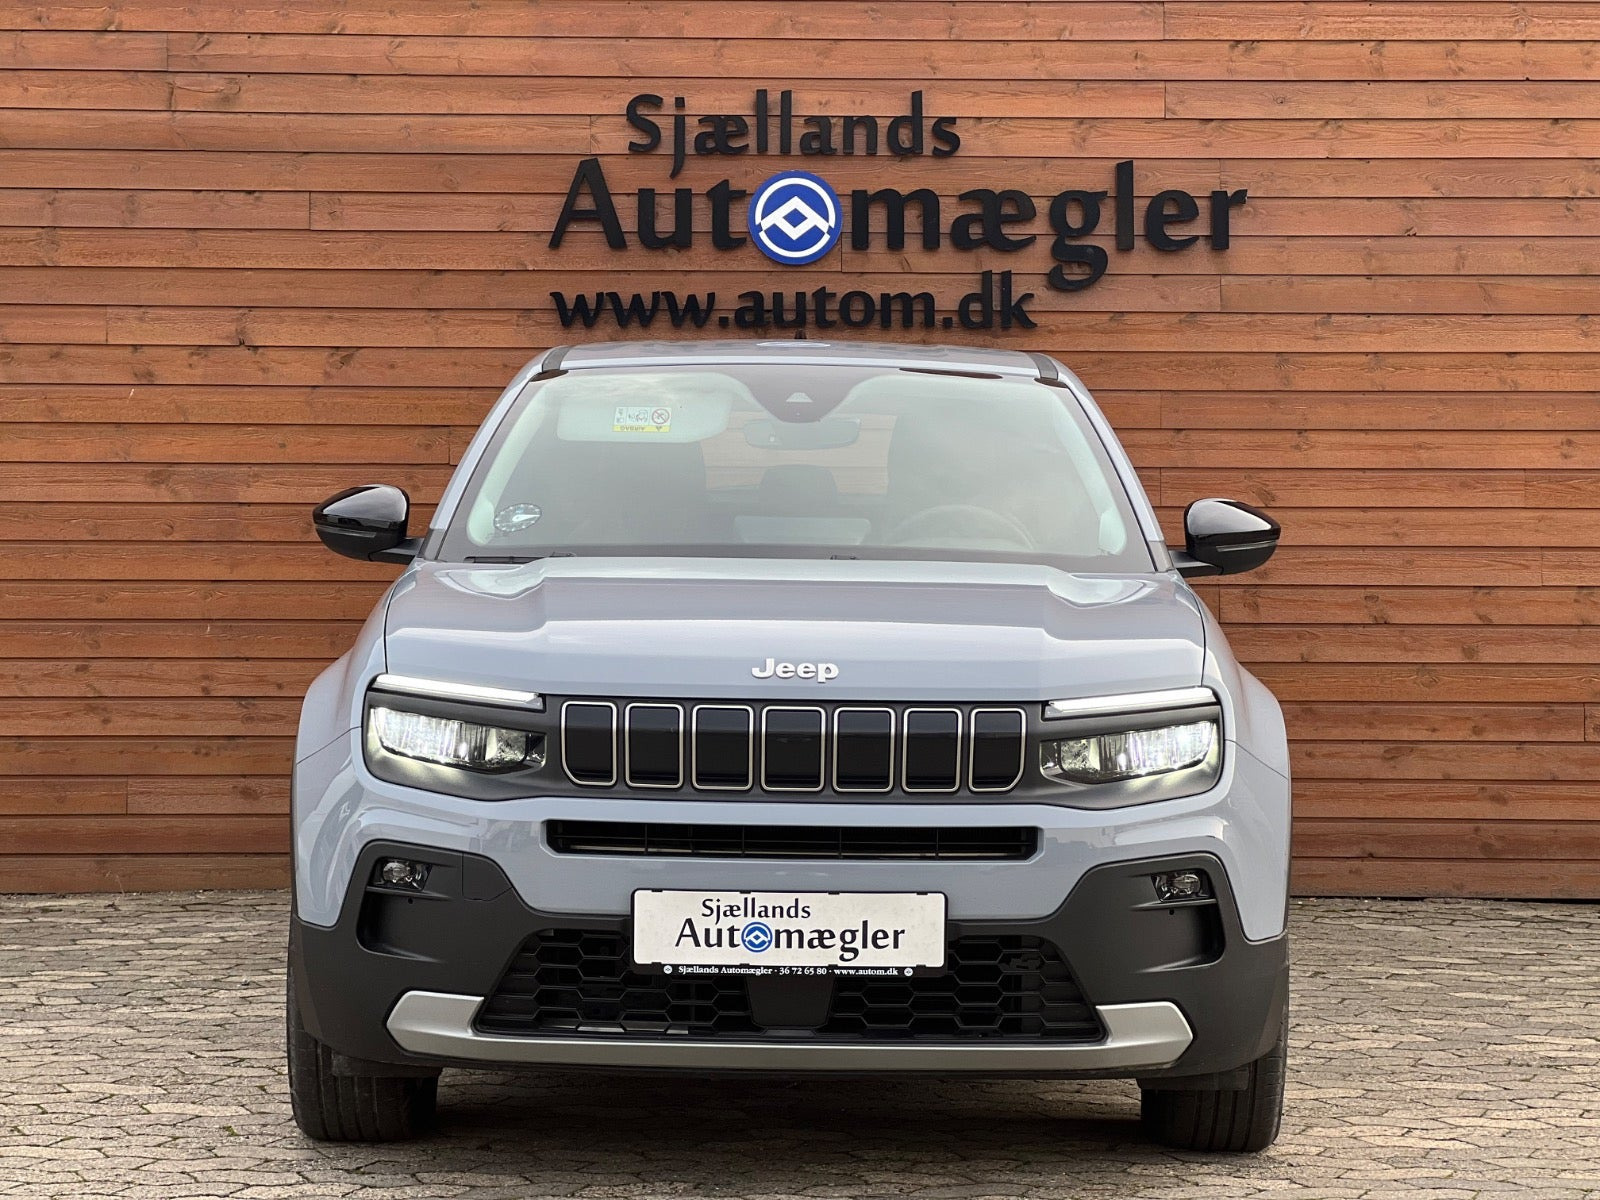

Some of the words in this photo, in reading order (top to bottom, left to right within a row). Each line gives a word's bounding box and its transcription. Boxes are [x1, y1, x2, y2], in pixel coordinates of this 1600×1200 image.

[626, 89, 961, 178] Sjællands
[549, 270, 1037, 330] www.autom.dk
[751, 657, 839, 684] Jeep
[701, 897, 811, 925] Sjællands
[678, 965, 719, 975] Sjællands
[720, 965, 773, 976] Automægler
[779, 966, 790, 975] 36
[792, 966, 803, 975] 72
[804, 966, 815, 976] 65
[816, 966, 828, 975] 80
[834, 967, 898, 976] www.autom.dk
